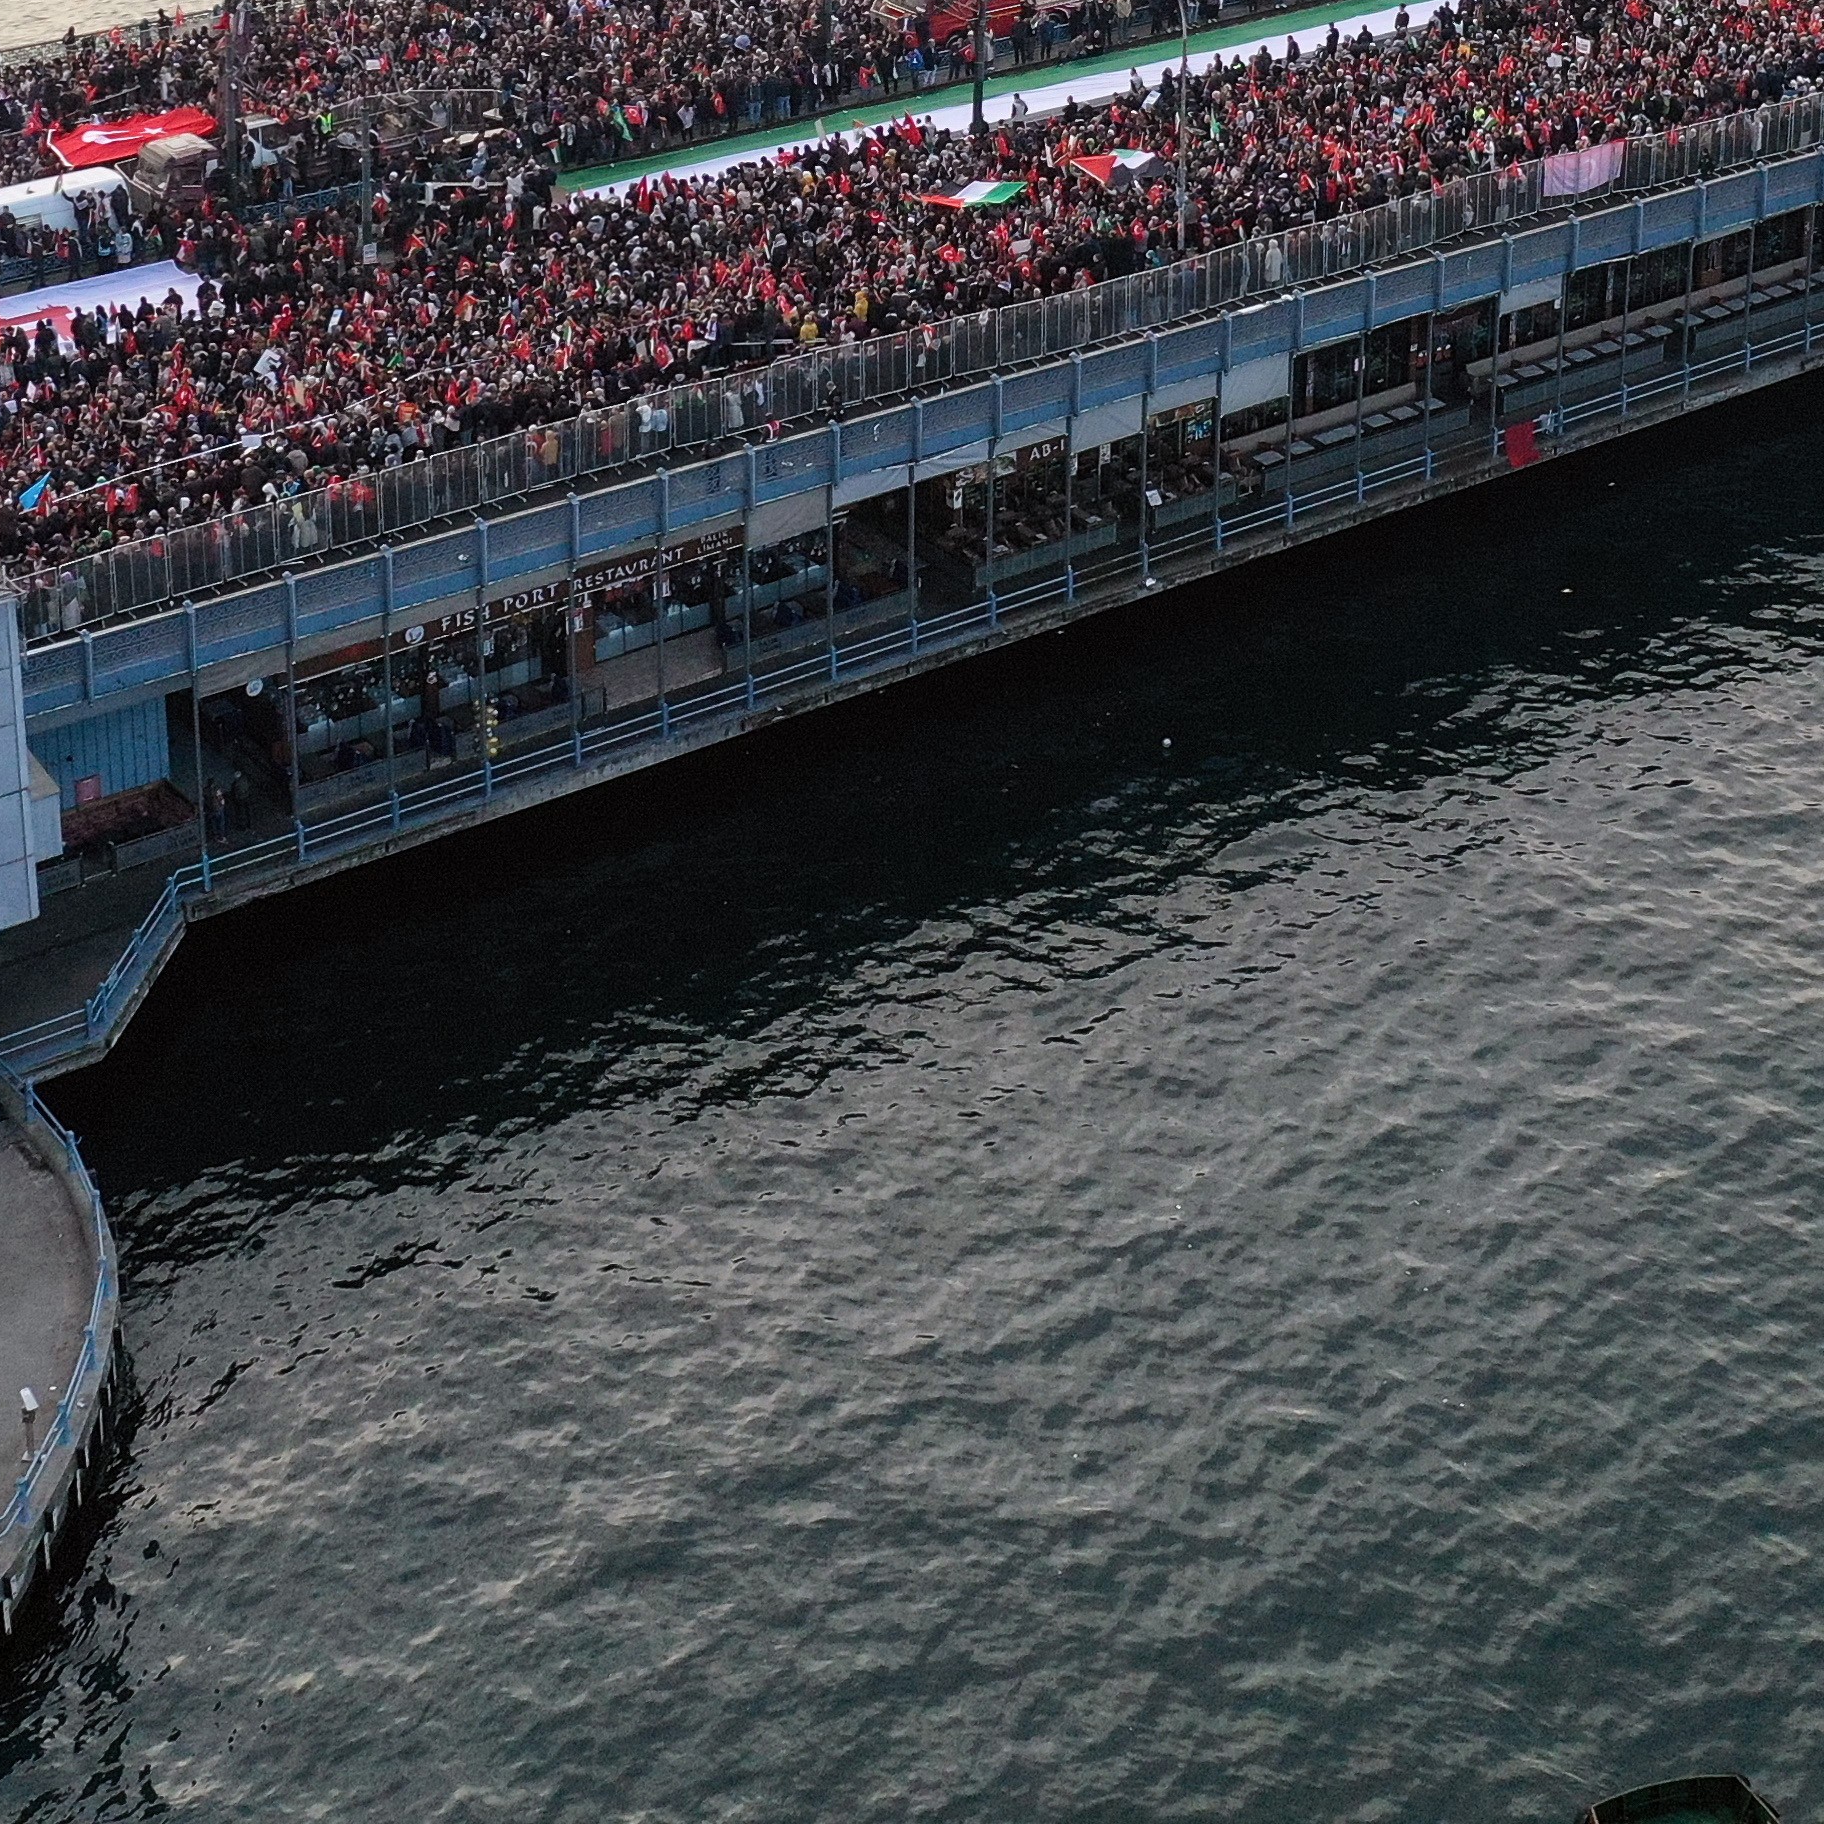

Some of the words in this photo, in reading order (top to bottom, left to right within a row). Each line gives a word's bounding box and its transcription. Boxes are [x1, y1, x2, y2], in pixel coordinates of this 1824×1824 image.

[440, 603, 491, 632] FISH
[503, 582, 560, 613] PORT
[572, 546, 685, 592] RESTAURANT
